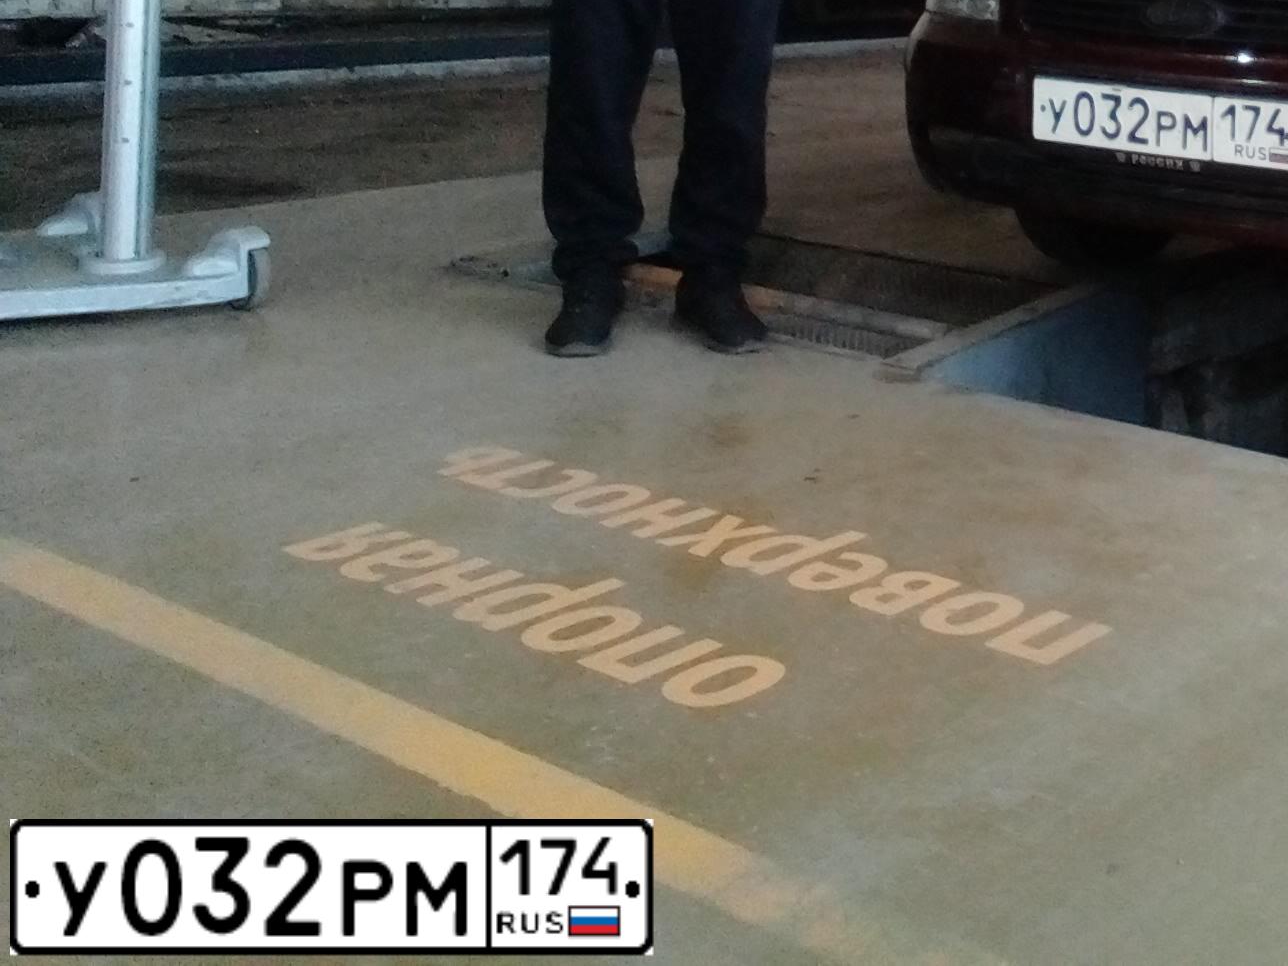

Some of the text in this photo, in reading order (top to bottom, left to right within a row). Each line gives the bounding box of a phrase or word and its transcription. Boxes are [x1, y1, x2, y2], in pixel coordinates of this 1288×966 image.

[1049, 90, 1288, 153] У032РМ 174
[1234, 144, 1268, 161] RUS
[281, 521, 787, 708] опорная
[437, 445, 1112, 665] поверхность
